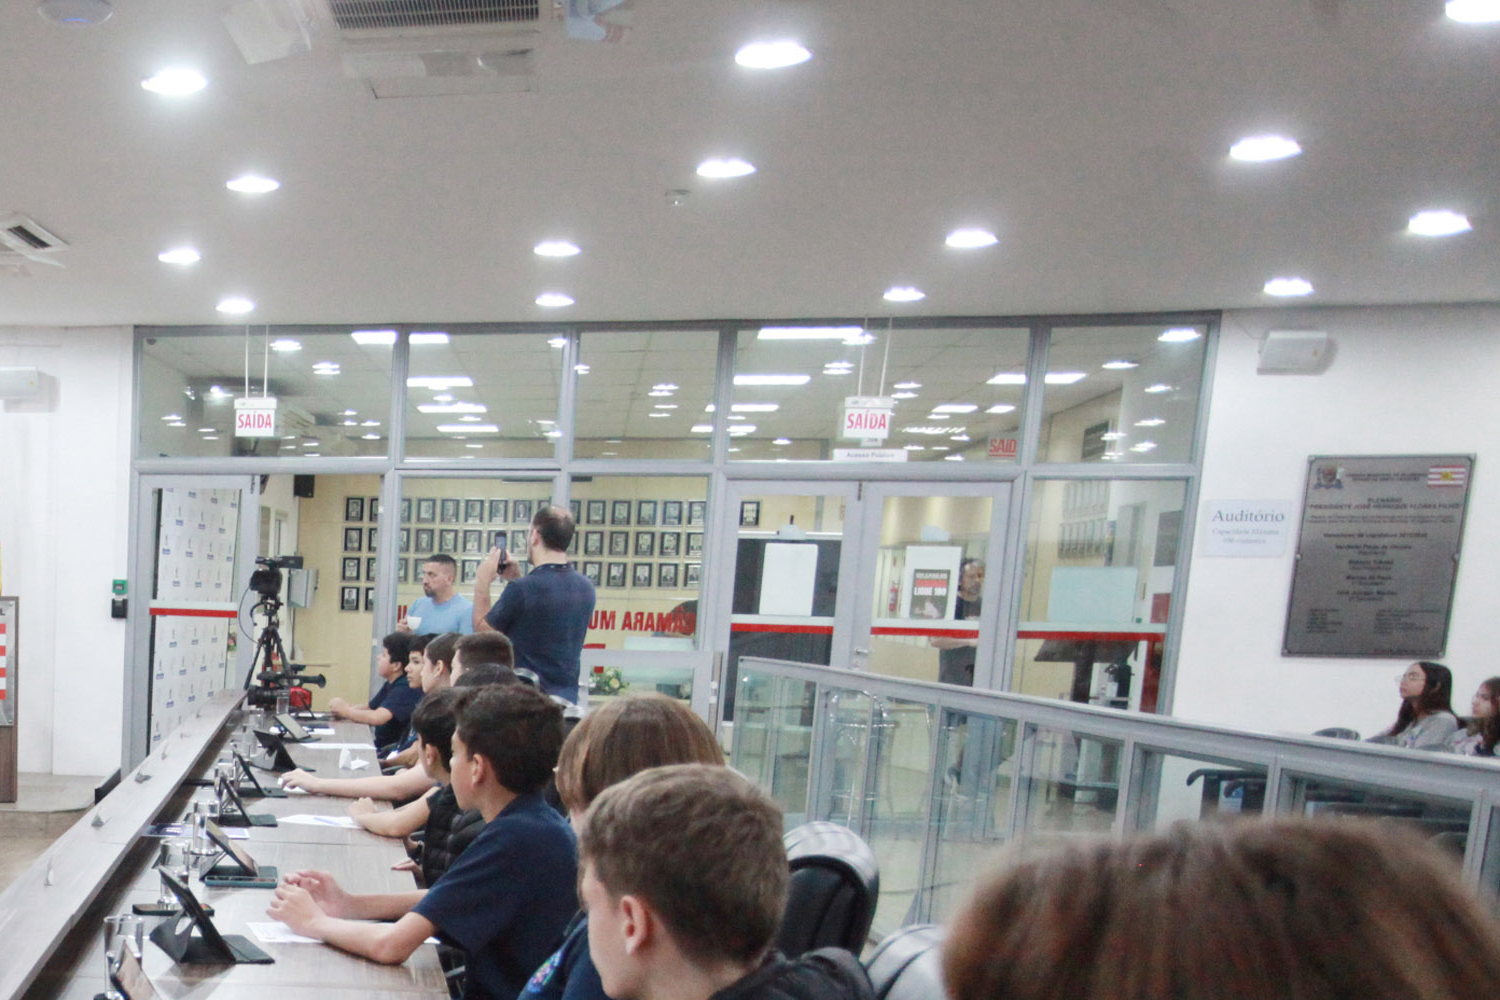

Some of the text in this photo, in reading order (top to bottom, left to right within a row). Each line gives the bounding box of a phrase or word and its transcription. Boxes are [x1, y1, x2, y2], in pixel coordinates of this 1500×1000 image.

[238, 410, 272, 429] SAÍDA
[846, 409, 887, 430] SAÍDA
[1211, 508, 1285, 523] Auditório
